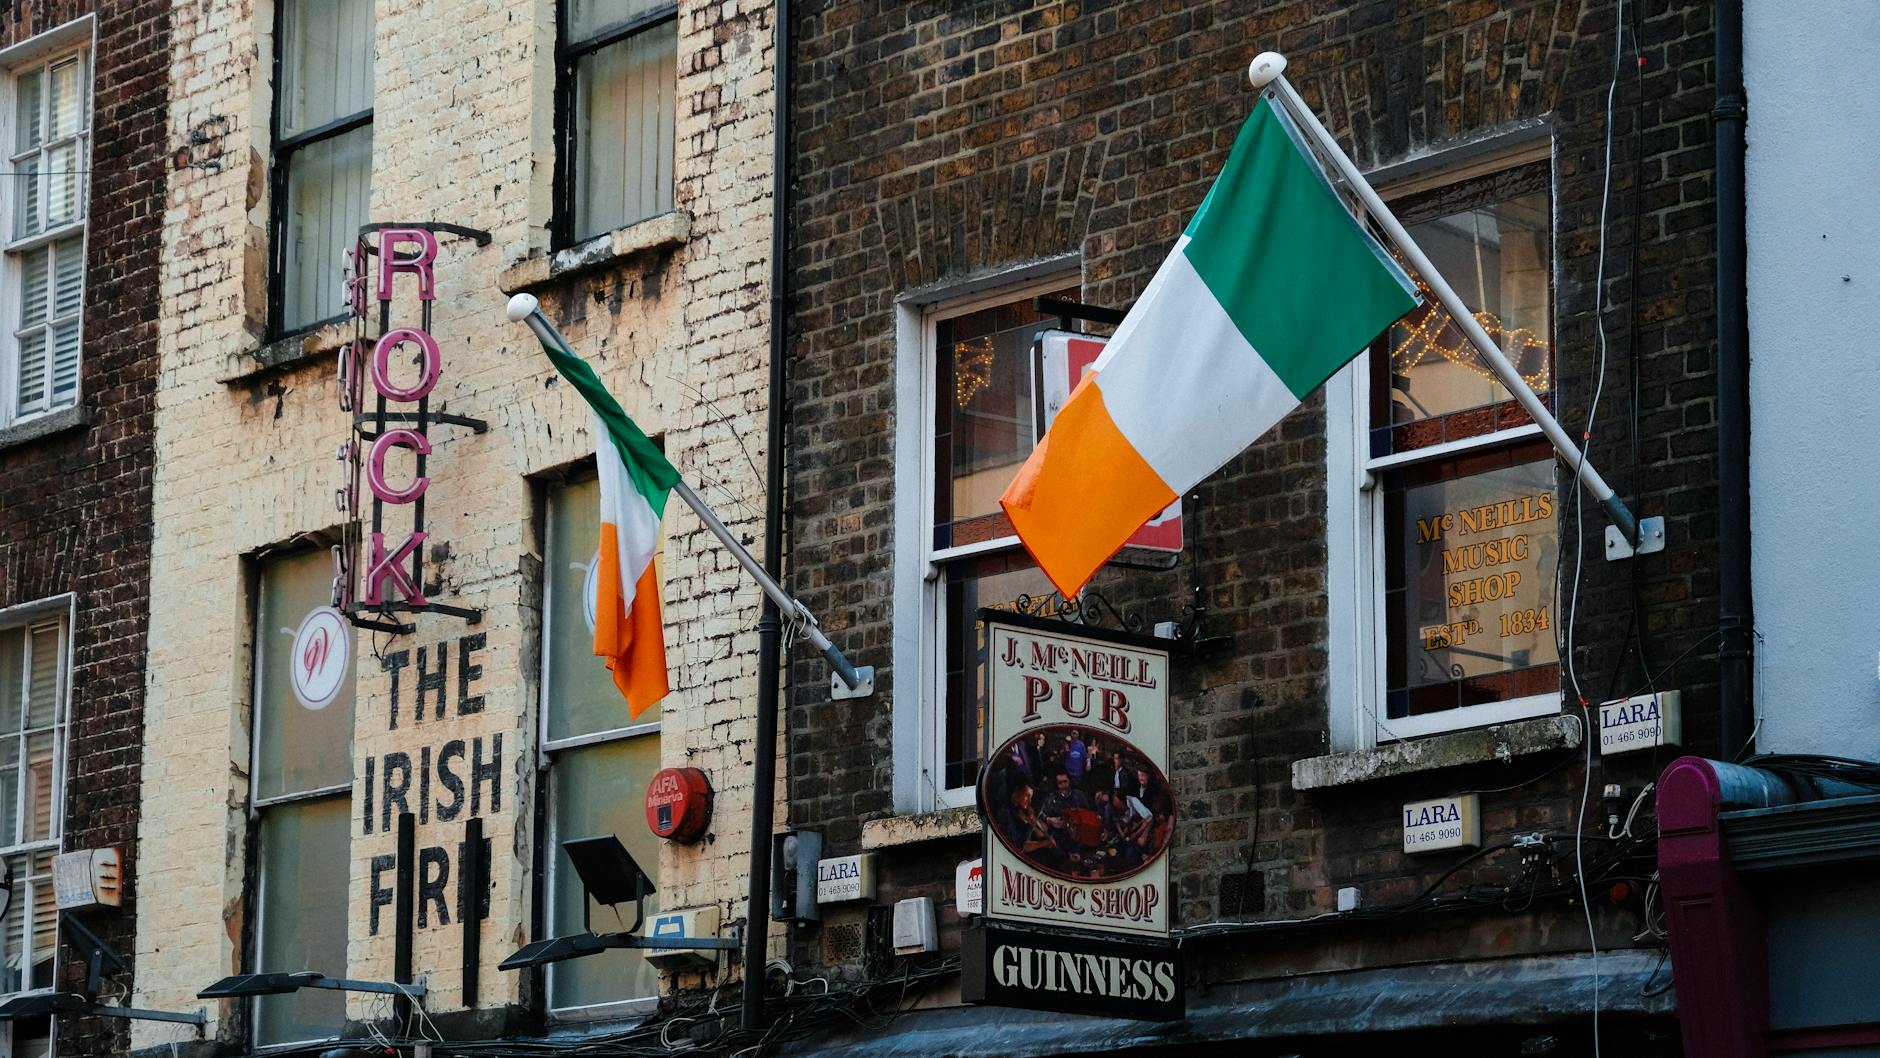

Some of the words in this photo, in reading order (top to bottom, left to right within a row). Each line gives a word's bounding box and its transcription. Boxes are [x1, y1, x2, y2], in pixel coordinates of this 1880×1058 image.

[364, 227, 441, 606] ROCK
[1459, 492, 1553, 536] NEILLS
[1441, 534, 1529, 575] MUSIC
[1448, 571, 1522, 608] SHOP
[1500, 606, 1549, 637] 1834
[1002, 637, 1024, 669] J.
[381, 632, 487, 731] THE
[1022, 674, 1132, 734] PUB
[1602, 701, 1661, 728] LARA
[1603, 735, 1614, 746] 01
[1618, 730, 1635, 743] 465
[1638, 726, 1662, 740] 9090
[363, 732, 503, 835] IRISH
[653, 775, 679, 795] AFA
[1405, 803, 1460, 828] LARA
[1406, 834, 1416, 844] 01
[1420, 830, 1436, 842] 465
[1439, 827, 1461, 839] 9090
[819, 861, 860, 882] LARA
[829, 884, 840, 895] 465
[1001, 864, 1086, 915] MUSIC
[1091, 884, 1159, 922] SHOP
[993, 945, 1176, 1003] GUINNESS
